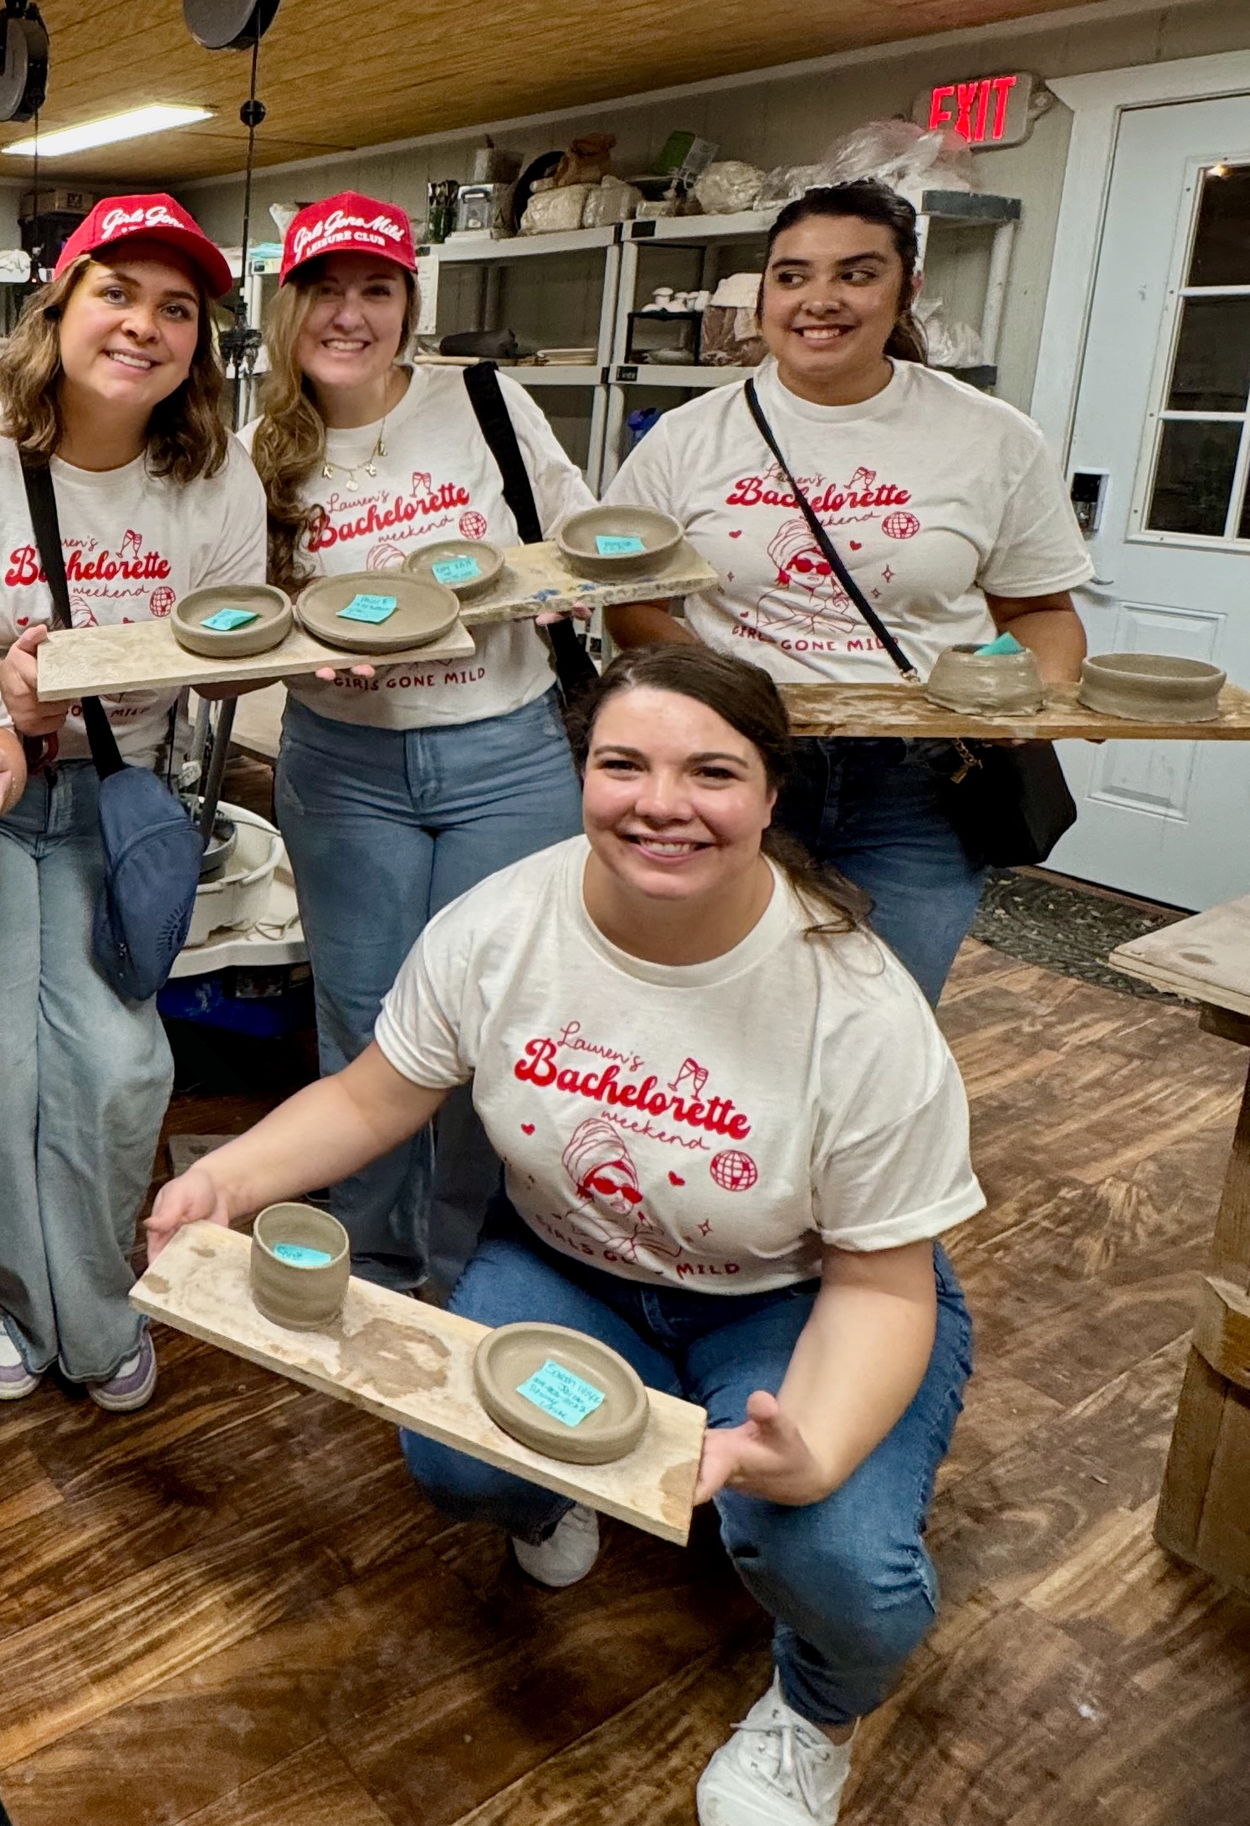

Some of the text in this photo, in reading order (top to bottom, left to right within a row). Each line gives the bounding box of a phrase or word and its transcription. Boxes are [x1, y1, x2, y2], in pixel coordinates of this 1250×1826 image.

[929, 76, 1017, 142] EXIT
[101, 208, 144, 240] Girls
[293, 210, 405, 264] Girls Gone Mild
[308, 481, 470, 553] Bachelorette
[326, 489, 390, 514] Lauren's
[378, 514, 454, 543] weekend
[73, 586, 150, 599] weekend
[781, 640, 836, 651] GONE
[386, 675, 434, 688] GONE
[444, 667, 485, 684] MILD
[557, 1021, 644, 1072] Lauren's
[514, 1037, 751, 1141] Bachelorette
[601, 1110, 710, 1150] weekend
[676, 1262, 740, 1280] MILD
